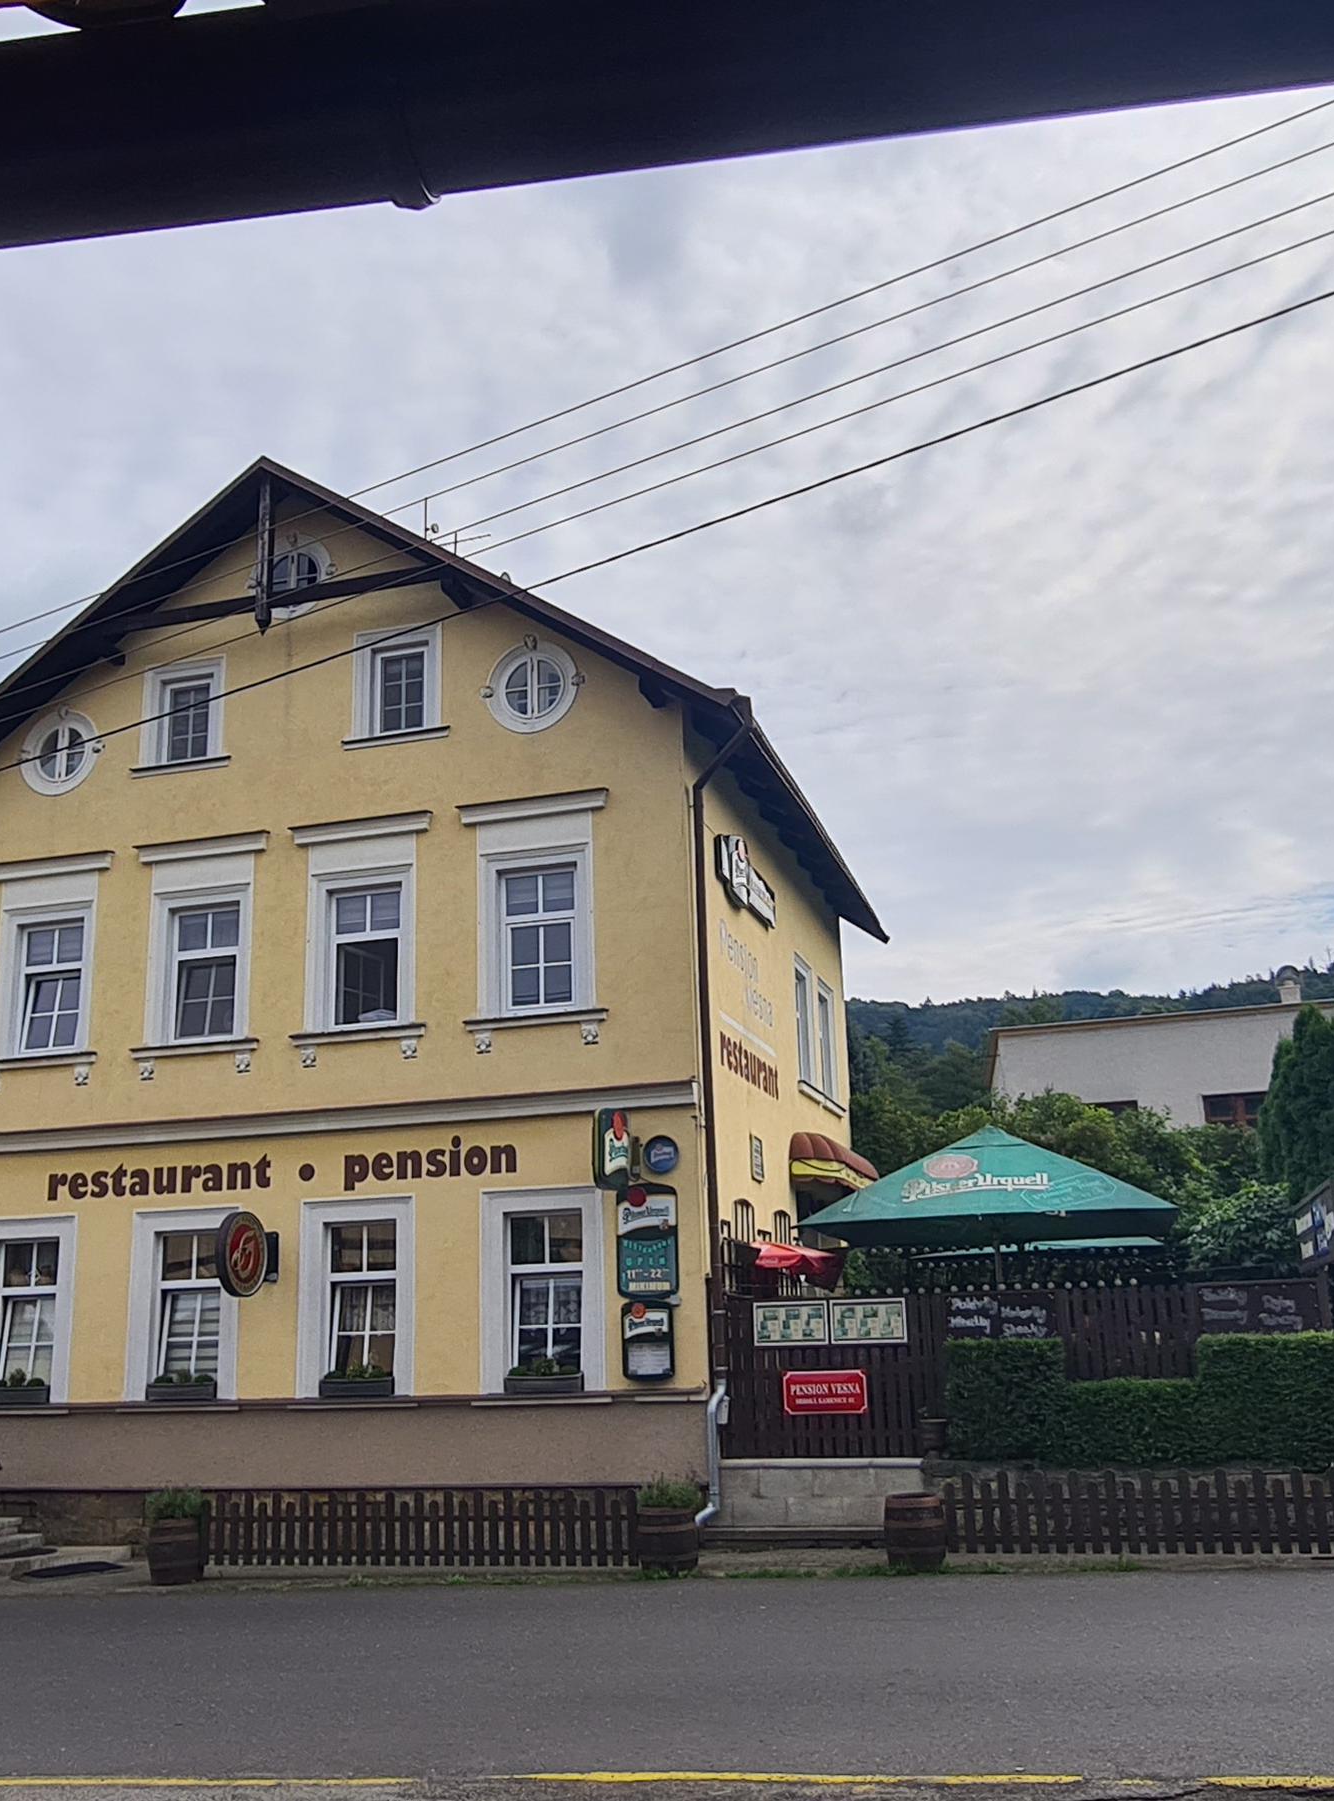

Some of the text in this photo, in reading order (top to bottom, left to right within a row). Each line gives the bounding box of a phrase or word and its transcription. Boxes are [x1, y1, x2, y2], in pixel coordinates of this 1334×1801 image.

[720, 1030, 780, 1101] restaurant
[47, 1135, 517, 1201] restaurant pension
[974, 1171, 1050, 1191] Urquell
[790, 1382, 861, 1396] PENSION VESNA
